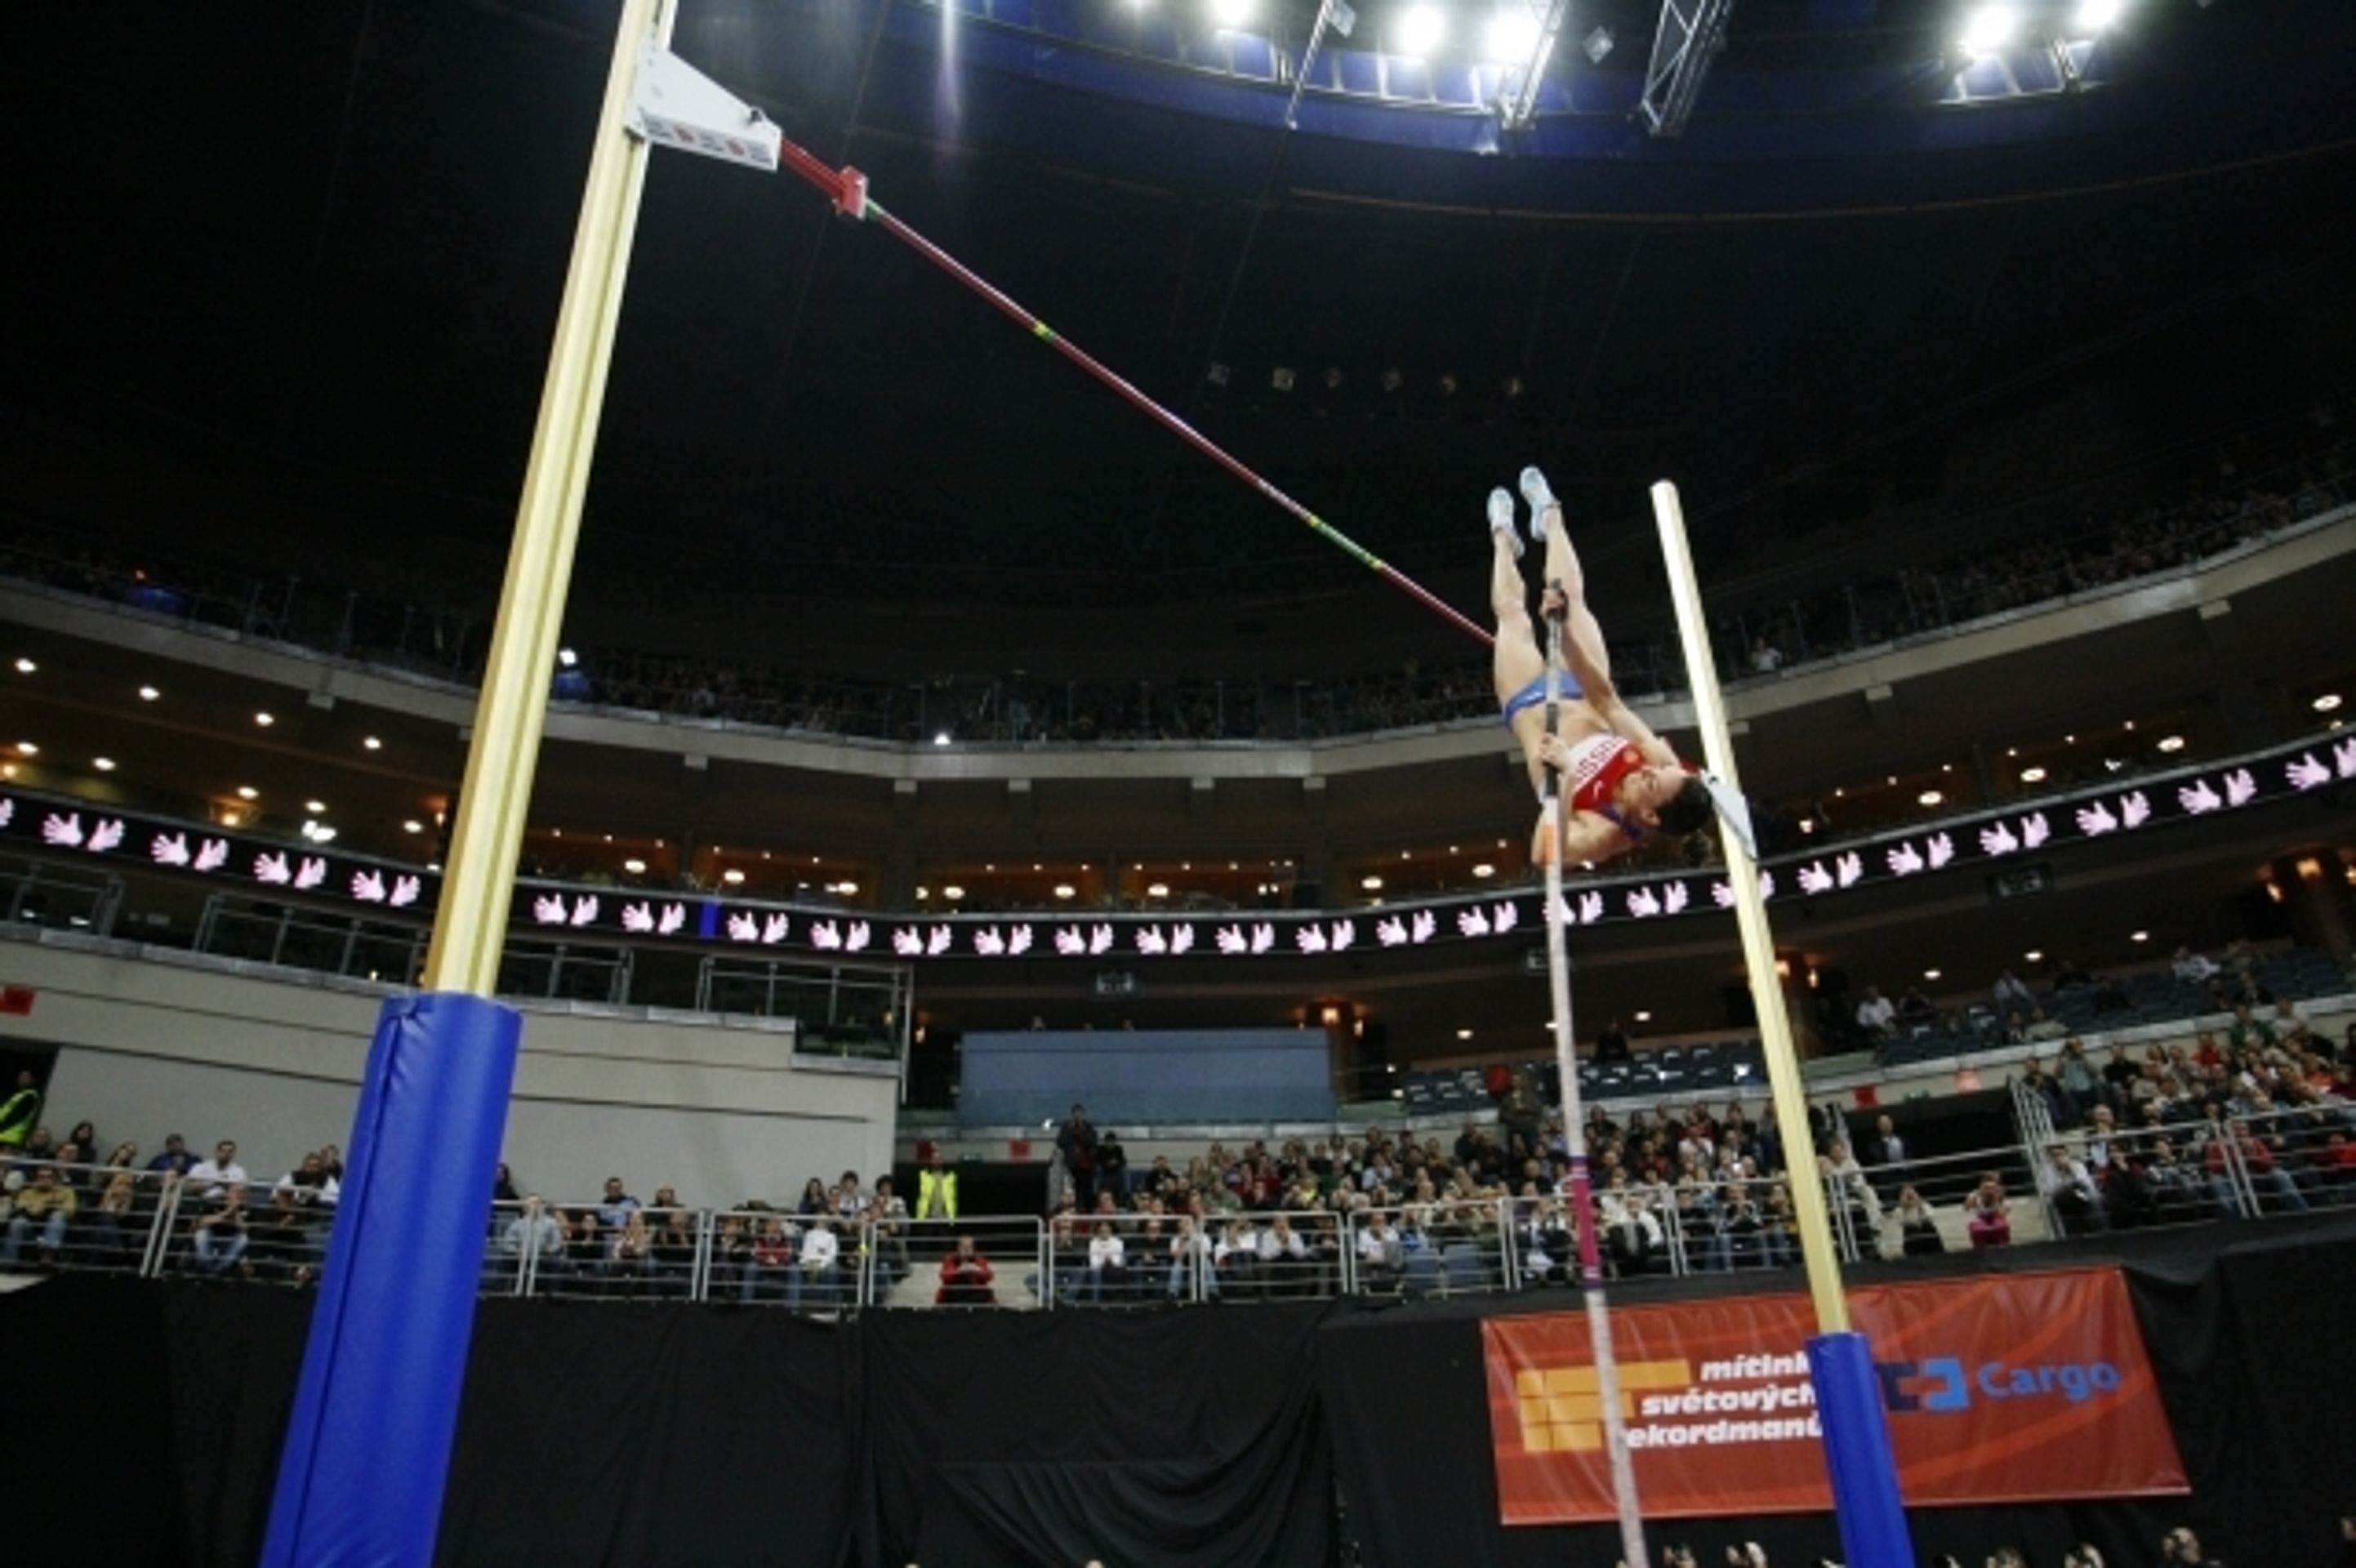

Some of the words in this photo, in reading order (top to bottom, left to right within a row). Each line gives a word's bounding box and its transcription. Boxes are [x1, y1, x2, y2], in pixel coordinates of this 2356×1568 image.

[1977, 1361, 2121, 1401] Cargo
[1642, 1383, 1816, 1415] světových
[1624, 1412, 1823, 1447] ekordmanů
